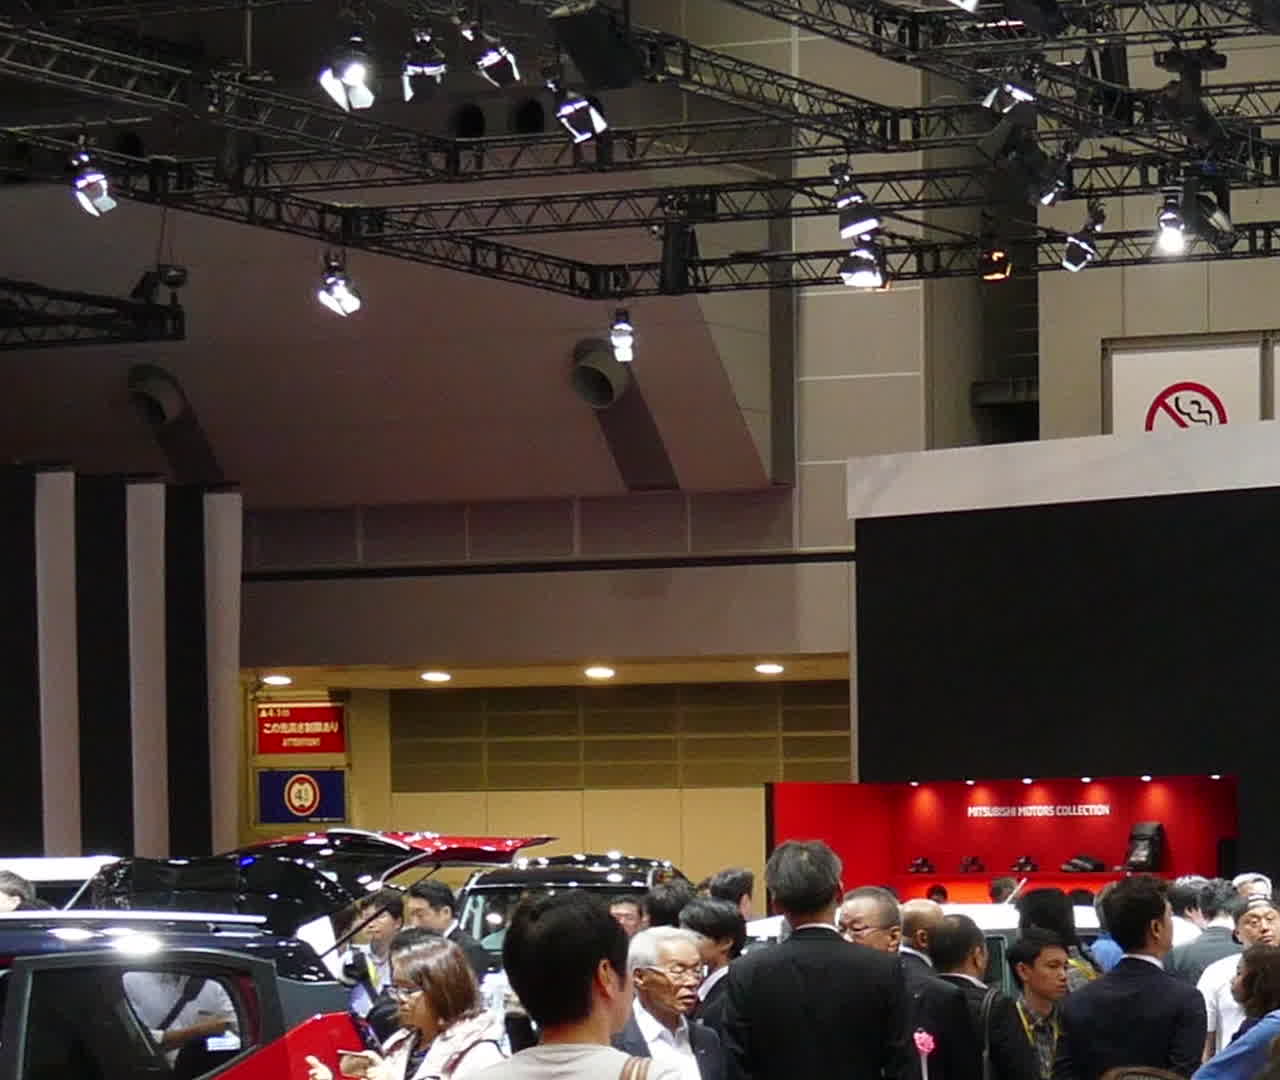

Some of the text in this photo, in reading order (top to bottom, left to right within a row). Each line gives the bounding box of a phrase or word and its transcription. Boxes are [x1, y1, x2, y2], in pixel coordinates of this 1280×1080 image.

[967, 804, 1110, 818] MITSUBISHI MOTORS COLLECTION
